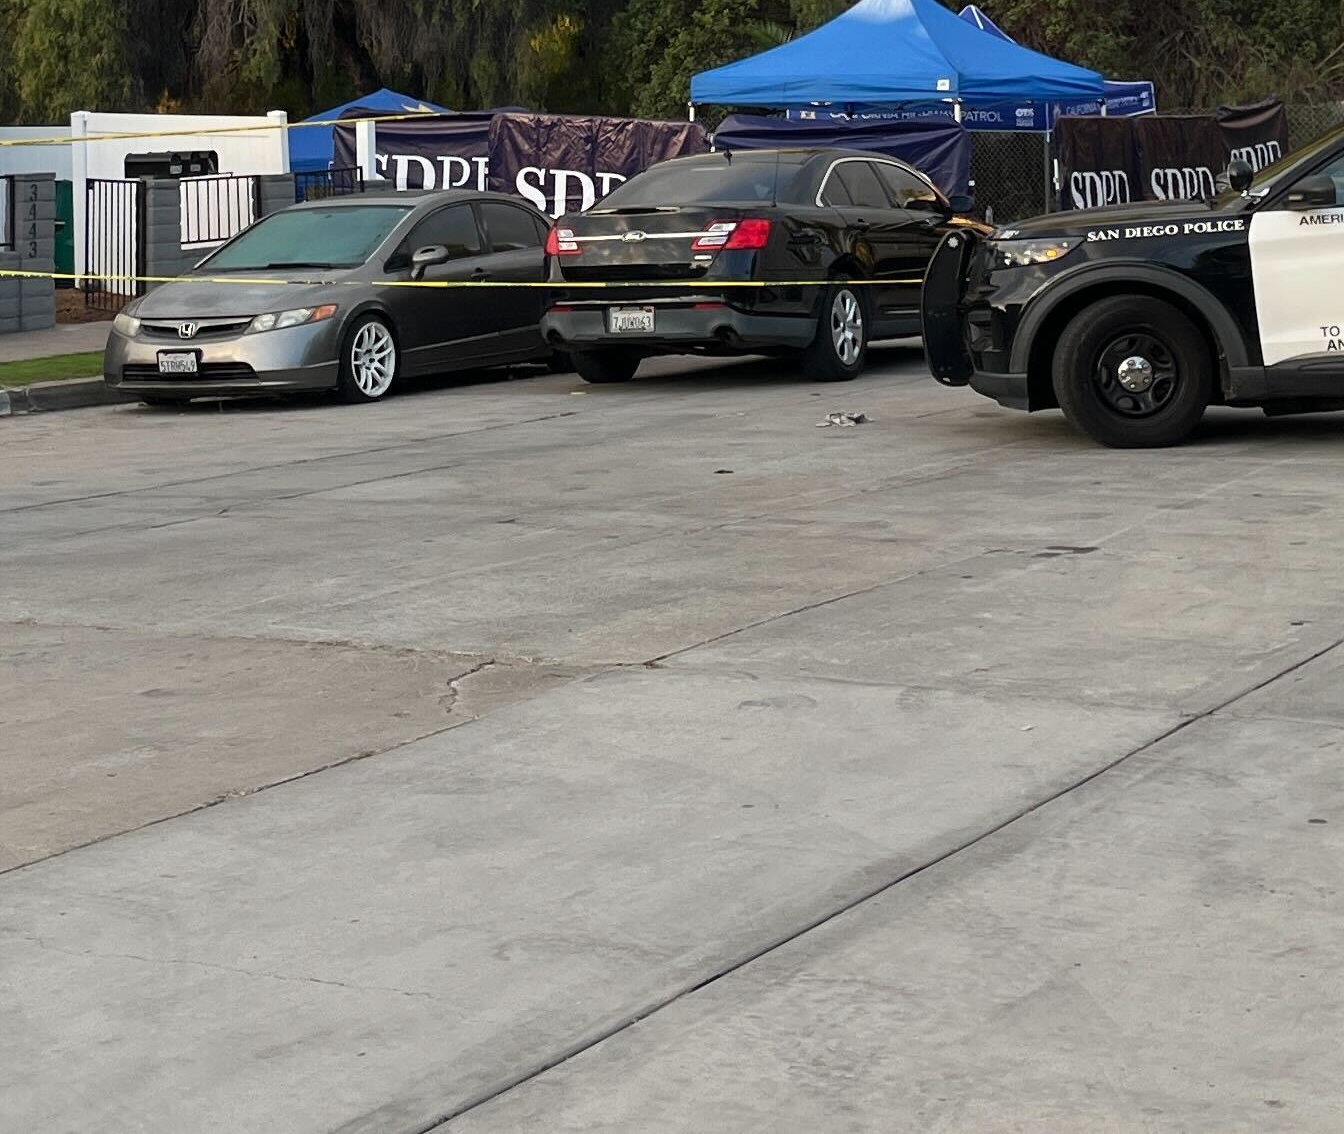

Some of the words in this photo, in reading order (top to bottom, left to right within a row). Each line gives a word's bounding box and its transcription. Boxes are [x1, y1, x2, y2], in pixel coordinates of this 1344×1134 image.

[960, 110, 1003, 122] PATROL
[1071, 170, 1130, 210] SDPD
[1151, 167, 1216, 202] SDPD
[1087, 228, 1120, 243] SAN
[1125, 223, 1178, 239] DIEGO
[1183, 219, 1246, 235] POLICE
[1320, 325, 1340, 337] TO
